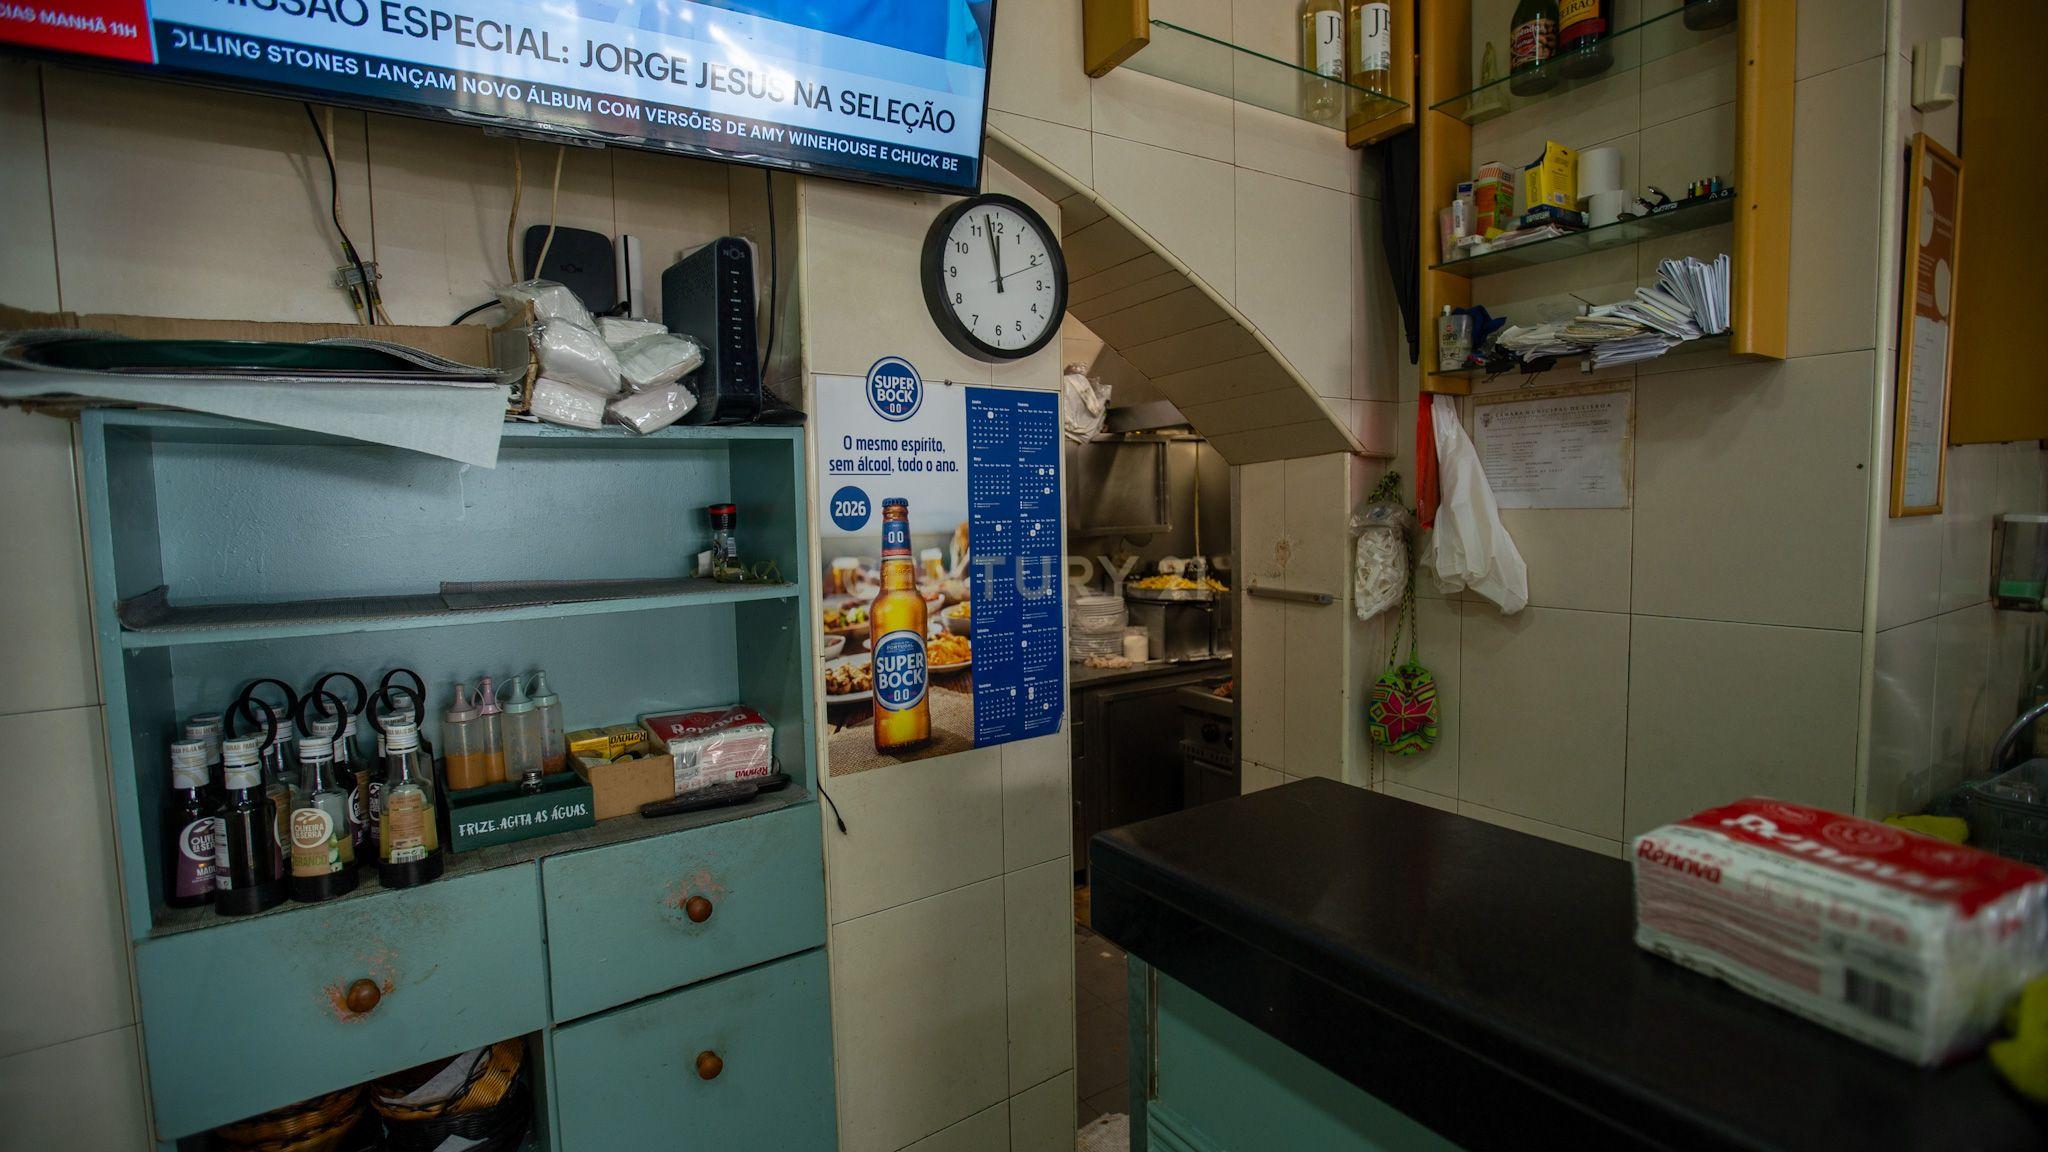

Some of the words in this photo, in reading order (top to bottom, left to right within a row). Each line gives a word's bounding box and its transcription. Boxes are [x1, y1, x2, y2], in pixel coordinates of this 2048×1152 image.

[40, 8, 107, 34] MANHÃ
[109, 21, 138, 38] 11H
[381, 0, 569, 64] ESPECIAL:
[579, 39, 688, 86] JORGE
[695, 61, 785, 103] JESUS
[793, 79, 833, 113] NA
[839, 89, 956, 134] SELEÇÃO
[267, 45, 358, 75] STONES
[365, 60, 456, 91] LANÇAM
[462, 77, 521, 101] NOVO
[527, 85, 592, 113] ÁLBUM
[597, 99, 640, 120] COM
[645, 106, 722, 132] VERSÕES
[726, 120, 747, 137] DE
[750, 125, 785, 143] AMY
[789, 130, 877, 158] WINEHOUSE
[880, 146, 888, 160] E
[890, 148, 939, 169] CHUCK
[942, 156, 959, 172] BE
[970, 225, 982, 237] 11
[991, 222, 1004, 234] 12
[1016, 233, 1021, 244] 1
[955, 241, 969, 254] 10
[1030, 254, 1036, 266] 2
[950, 266, 957, 278] 9
[1036, 280, 1042, 291] 3
[955, 293, 963, 304] 8
[1030, 303, 1037, 314] 4
[971, 314, 979, 326] 7
[1015, 321, 1022, 332] 5
[995, 325, 1002, 336] 6
[874, 374, 915, 391] SUPER
[877, 388, 914, 403] BOCK
[843, 435, 852, 450] O
[856, 438, 898, 452] mesmo
[901, 435, 946, 456] espírito,
[829, 459, 854, 472] sem
[857, 455, 895, 474] álcool,
[897, 456, 924, 472] todo
[926, 460, 933, 472] o
[935, 460, 959, 473] ano.
[835, 500, 867, 518] 2026
[876, 652, 925, 673] SUPER
[878, 669, 923, 690] BOCK
[735, 766, 769, 779] Renova
[459, 820, 499, 837] FRIZE.
[500, 813, 532, 830] AGITA
[534, 809, 548, 823] AS
[551, 803, 589, 820] ÁGUAS.
[1636, 838, 1723, 885] Renova
